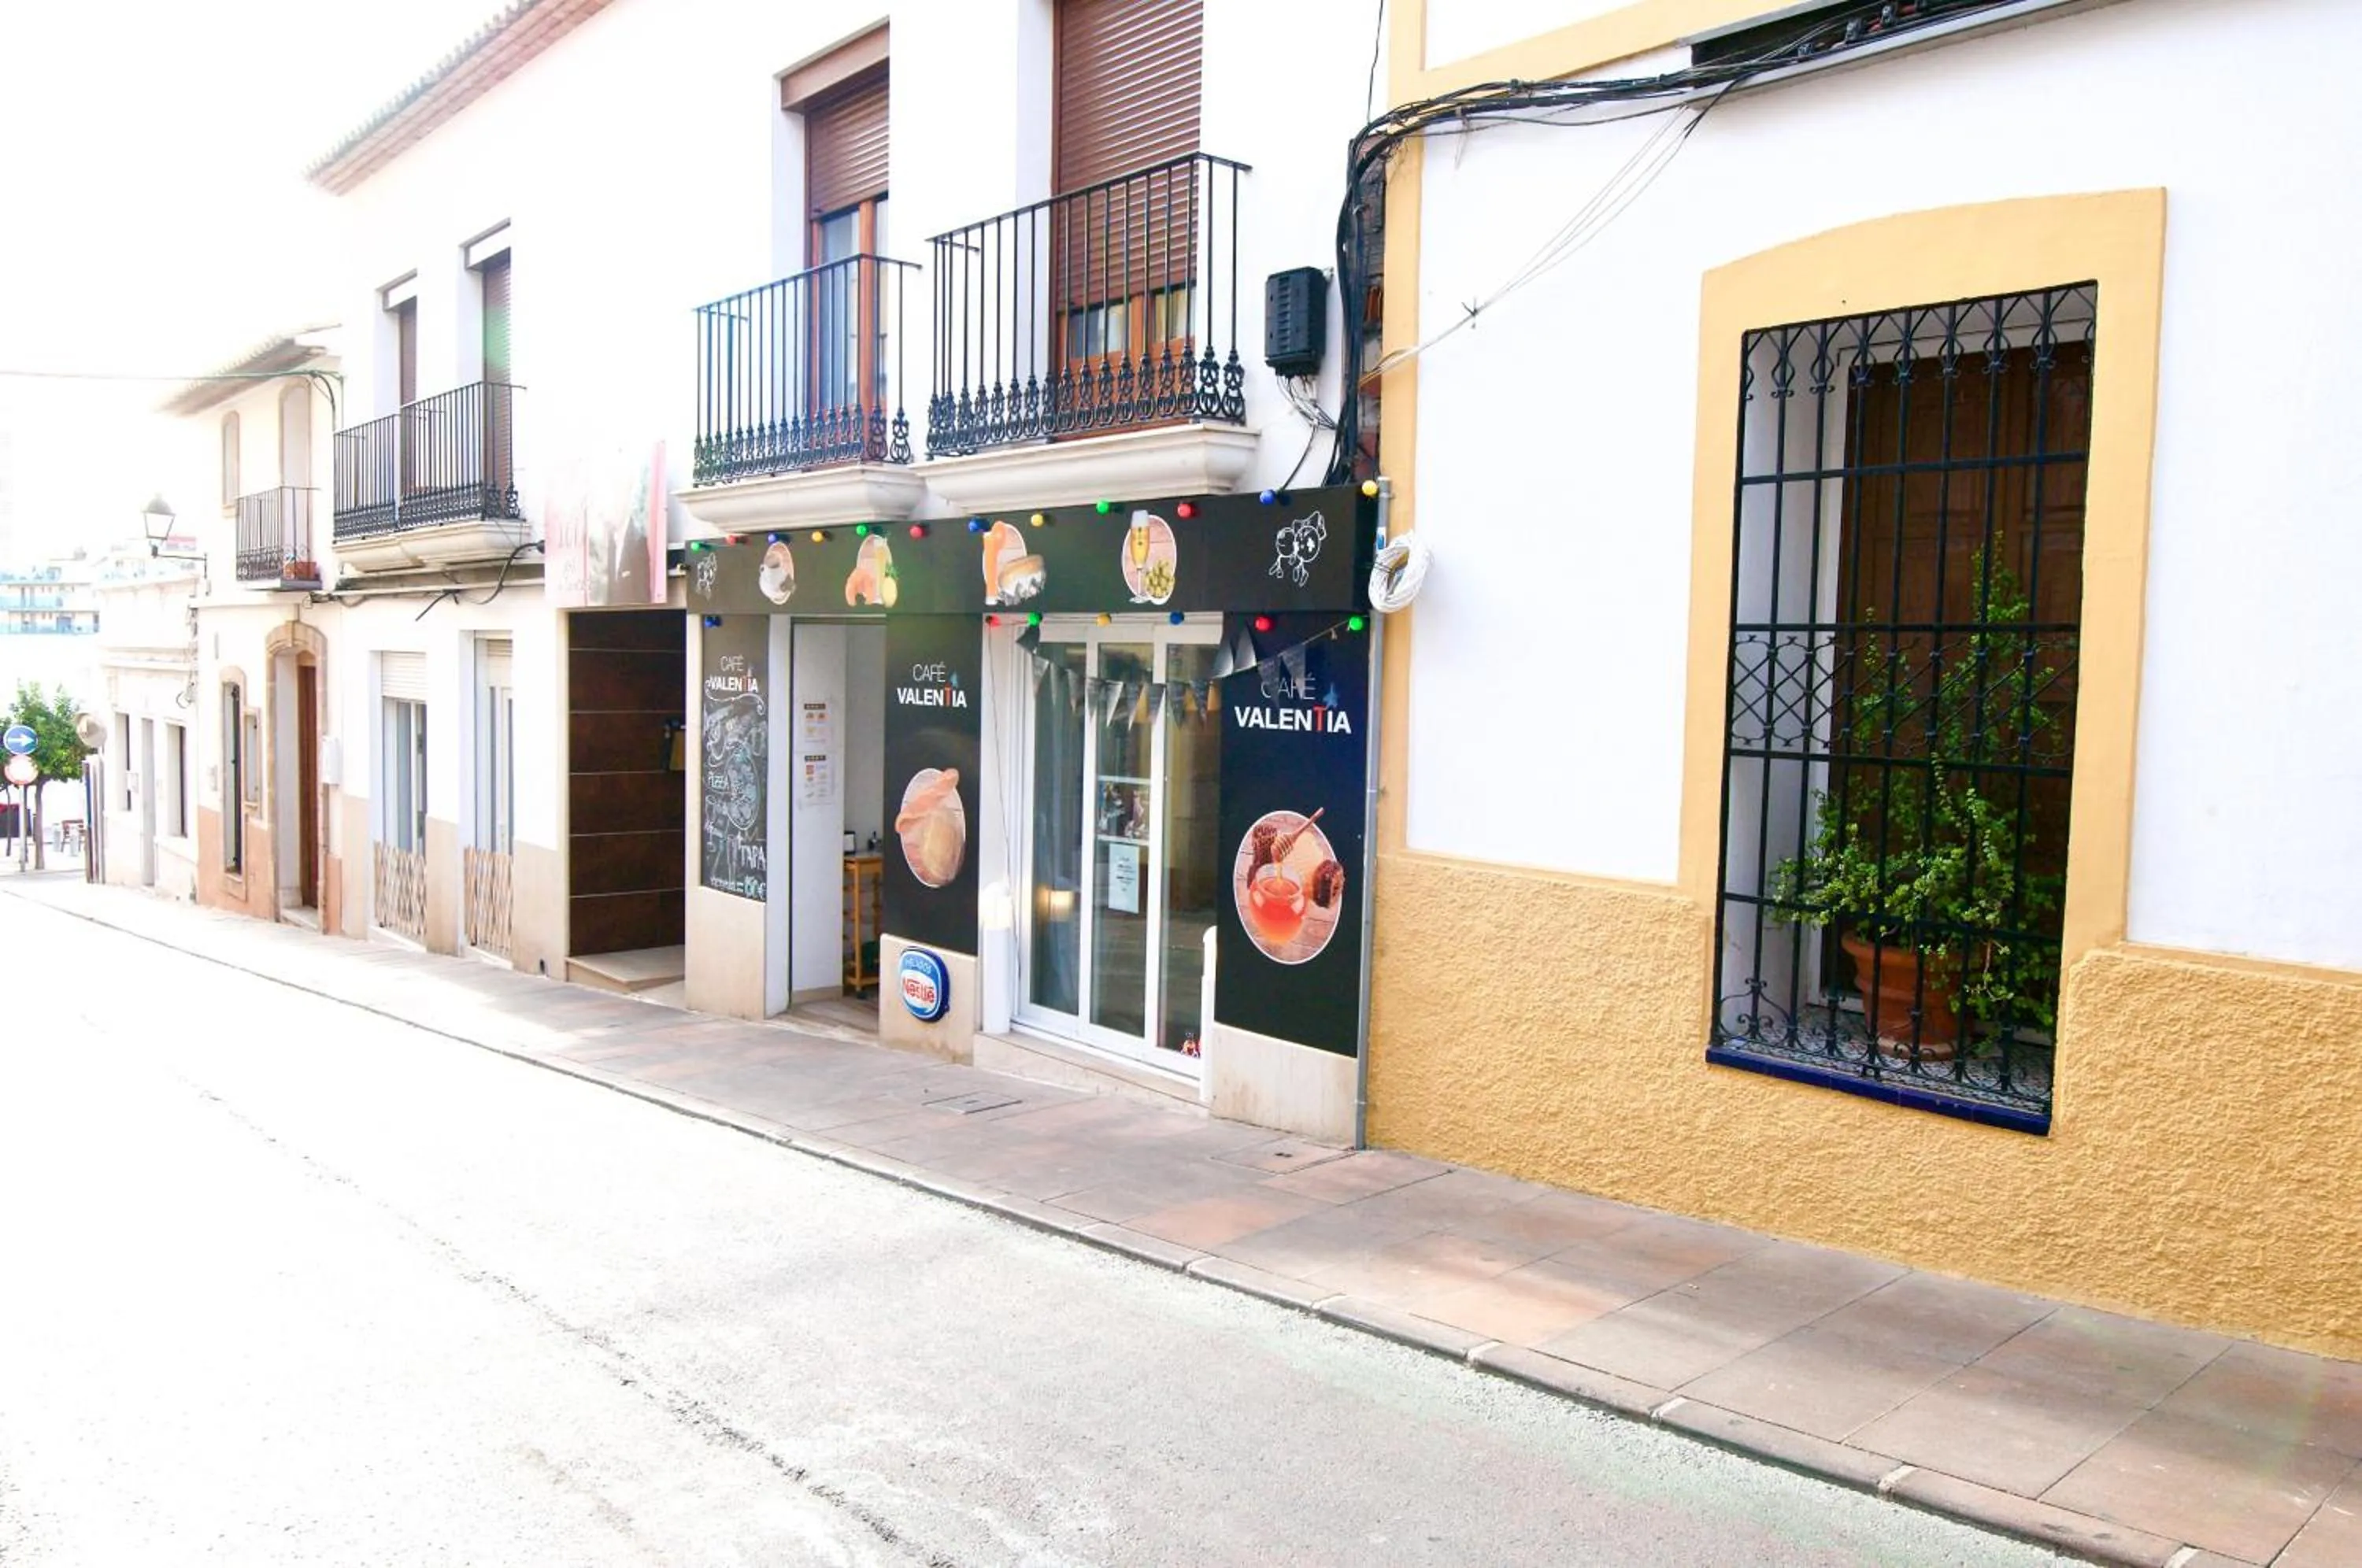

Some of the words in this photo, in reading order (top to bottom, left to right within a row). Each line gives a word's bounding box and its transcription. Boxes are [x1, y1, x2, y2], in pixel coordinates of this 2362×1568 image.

[720, 654, 744, 671] CAFÉ
[913, 661, 946, 682] CAFÉ
[710, 675, 758, 693] VALENTIA
[897, 686, 967, 708] VALENTIA
[1234, 704, 1352, 734] VALENTIA
